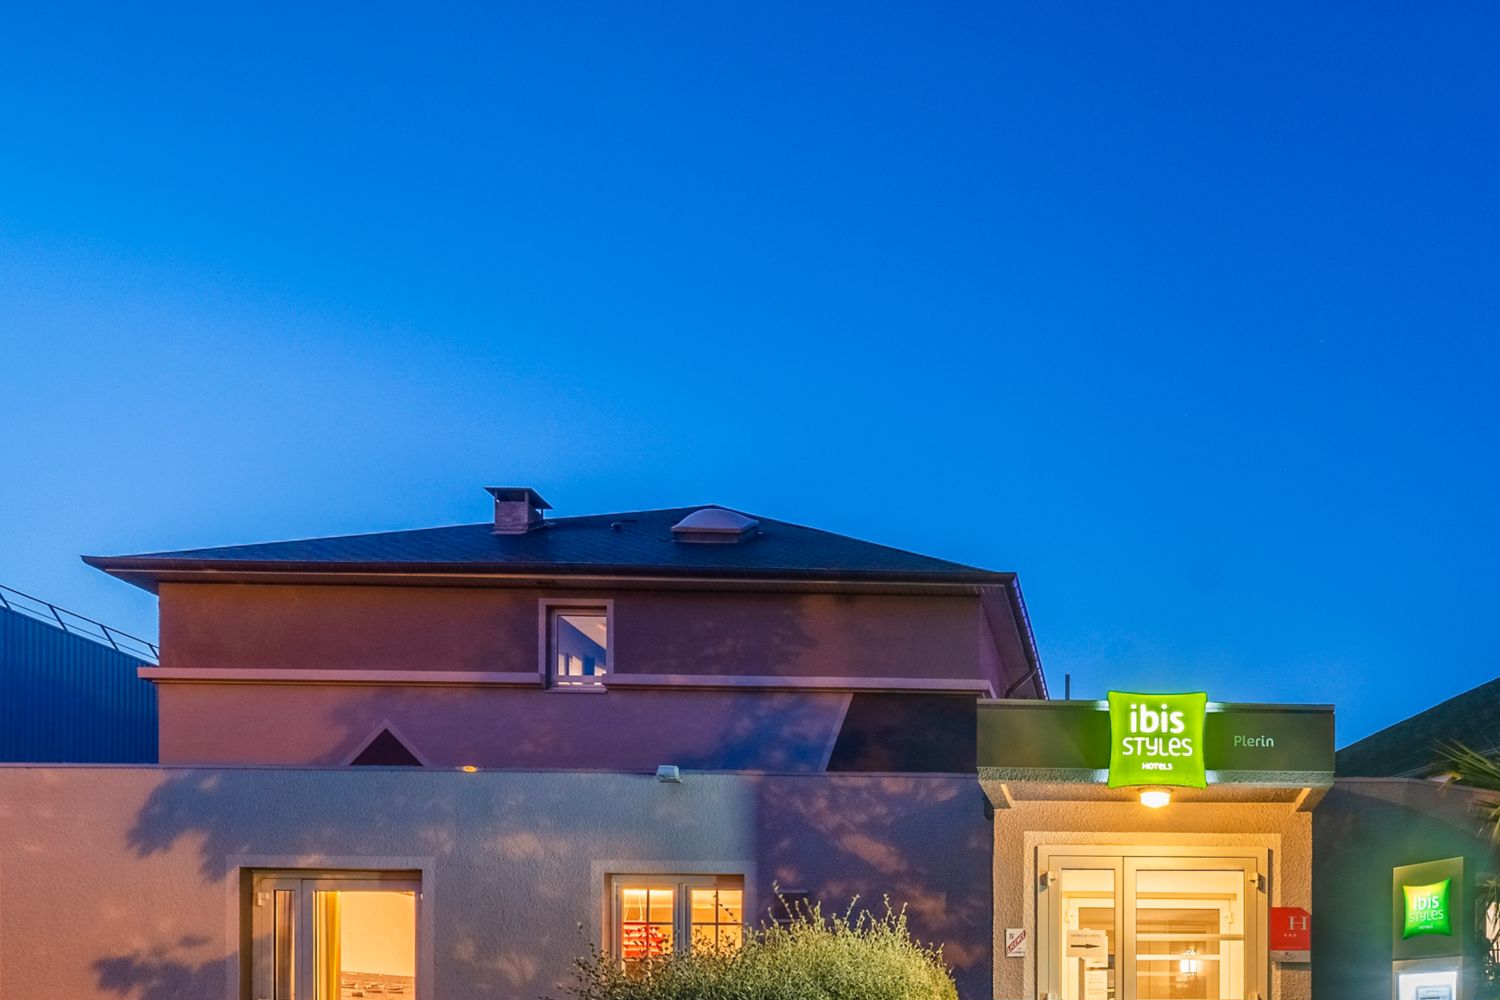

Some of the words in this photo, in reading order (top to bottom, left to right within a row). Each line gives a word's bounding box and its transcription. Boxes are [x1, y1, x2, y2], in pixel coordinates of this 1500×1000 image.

[1130, 703, 1185, 734] ibis
[1233, 735, 1274, 747] Plerin
[1141, 762, 1173, 771] HOTELS
[1413, 893, 1440, 910] ibis
